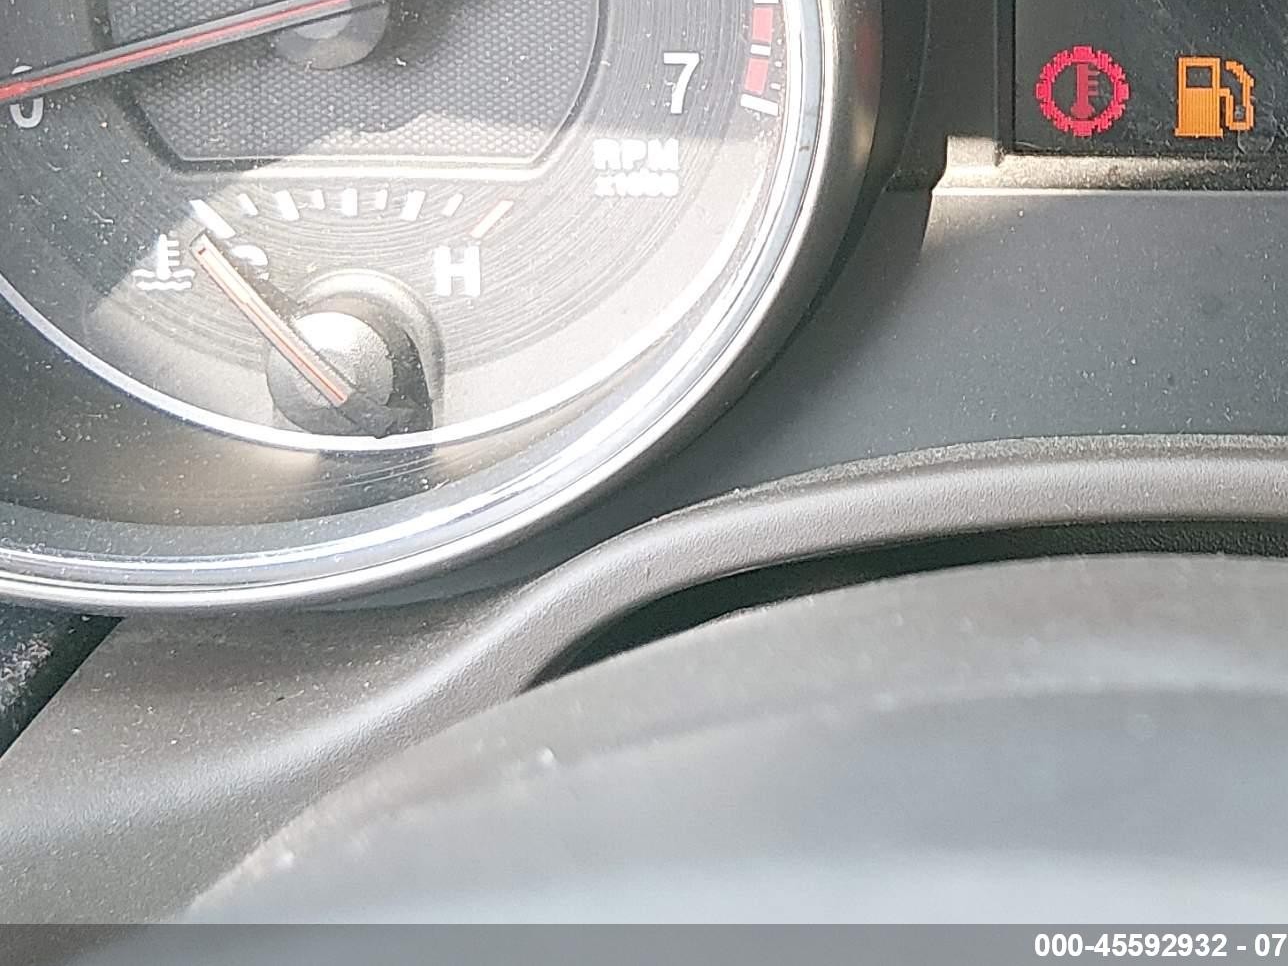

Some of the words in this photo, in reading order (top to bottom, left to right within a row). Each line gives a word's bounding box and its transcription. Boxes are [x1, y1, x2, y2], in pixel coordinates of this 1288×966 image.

[662, 52, 700, 115] 7
[592, 139, 681, 171] RPM
[432, 246, 482, 298] H
